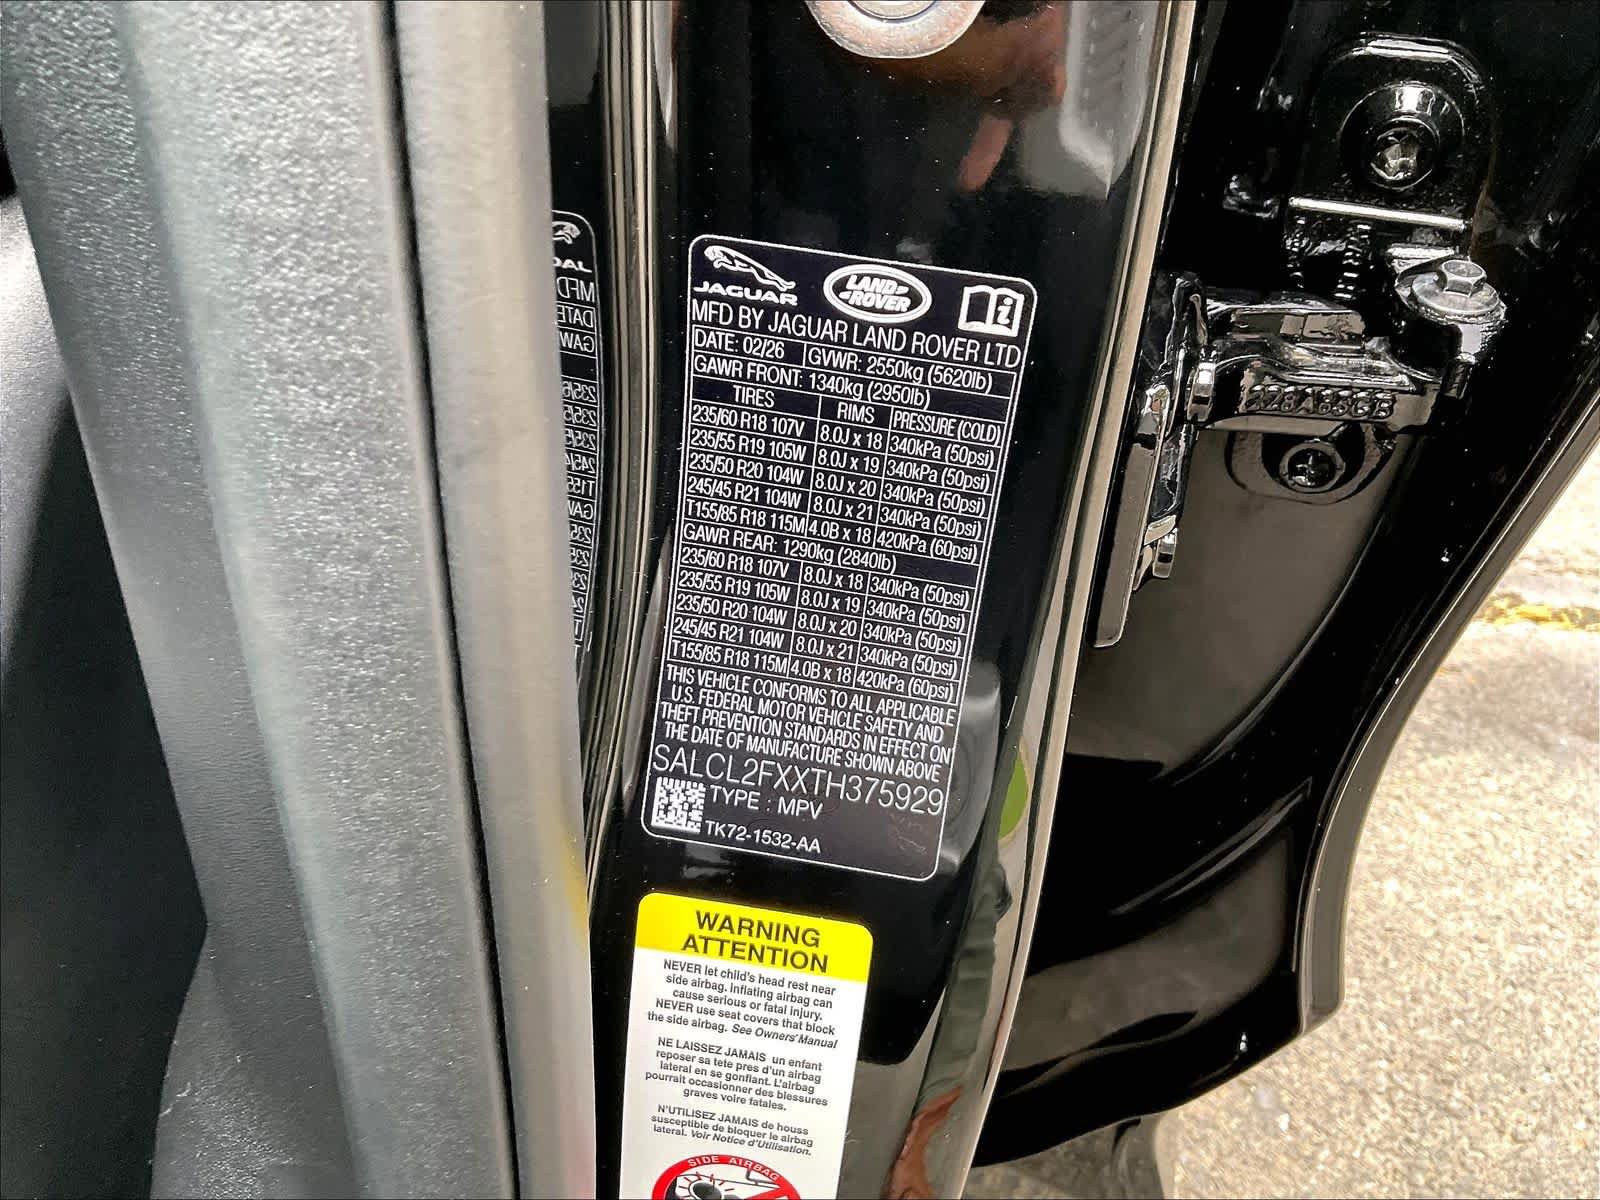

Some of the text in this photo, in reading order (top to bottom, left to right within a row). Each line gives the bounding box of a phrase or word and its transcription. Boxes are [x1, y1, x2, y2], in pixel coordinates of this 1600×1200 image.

[693, 280, 797, 306] JAGUAR
[845, 272, 898, 297] LAND
[847, 288, 911, 314] ROVER
[691, 298, 1021, 368] MFD BY JAGUAR LAND ROVER LTD
[693, 328, 992, 394] DATE: 02/26 GVWR: 2550kg (5620lb)
[694, 354, 930, 409] GAWR FRONT: 1340kg (2950lb)
[692, 404, 994, 469] 235/60 R18 107V 8.0J x 18 340kPa (50psi)
[732, 384, 1001, 445] TIRES RIMS PRESSURE (COLD)
[686, 499, 977, 564] T155/85 R18 115M 4.0B x 18 420kPa (60psi)
[687, 476, 981, 541] 245/45 R21 104W 8.0J x 21 340kPa (50psi)
[683, 522, 896, 575] GAWR REAR: 1290kg (2840lb)
[671, 639, 953, 702] T155/85 R18 115M 4.0B x 18 420kPa (60psi)
[673, 617, 957, 679] 245/45 R21 104W 8.0J x 21 340kPa (50psi)
[666, 663, 956, 727] THIS VEHICLE CONFORMS TO ALL APPLICABLE
[671, 684, 944, 743] U.S. FEDERAL MOTOR VEHICLE SAFETY AND
[660, 701, 951, 764] THEFT PREVENTION STANDARDS IN EFFECT ON
[664, 720, 941, 782] THE DATE OF MANUFACTURE SHOWN ABOVE
[652, 744, 944, 816] SALCL2FXXTH375929
[709, 784, 760, 810] TYPE
[777, 796, 823, 819] MPV
[705, 820, 820, 852] TK72-1532-AA
[681, 933, 828, 973] ATTENTION
[695, 910, 820, 948] WARNING
[663, 959, 836, 995] NEVER let child's head rest near
[665, 973, 832, 1008] side airbag. Inflating airbag can
[647, 1010, 663, 1022] the
[665, 1014, 688, 1026] side
[691, 1017, 727, 1033] airbag.
[731, 1023, 752, 1035] See
[797, 1033, 838, 1048] Manual
[655, 998, 835, 1035] NEVER use seat covers that block
[672, 989, 822, 1022] cause serious or fatal injury.
[687, 1155, 780, 1182] SIDE AIRBAG
